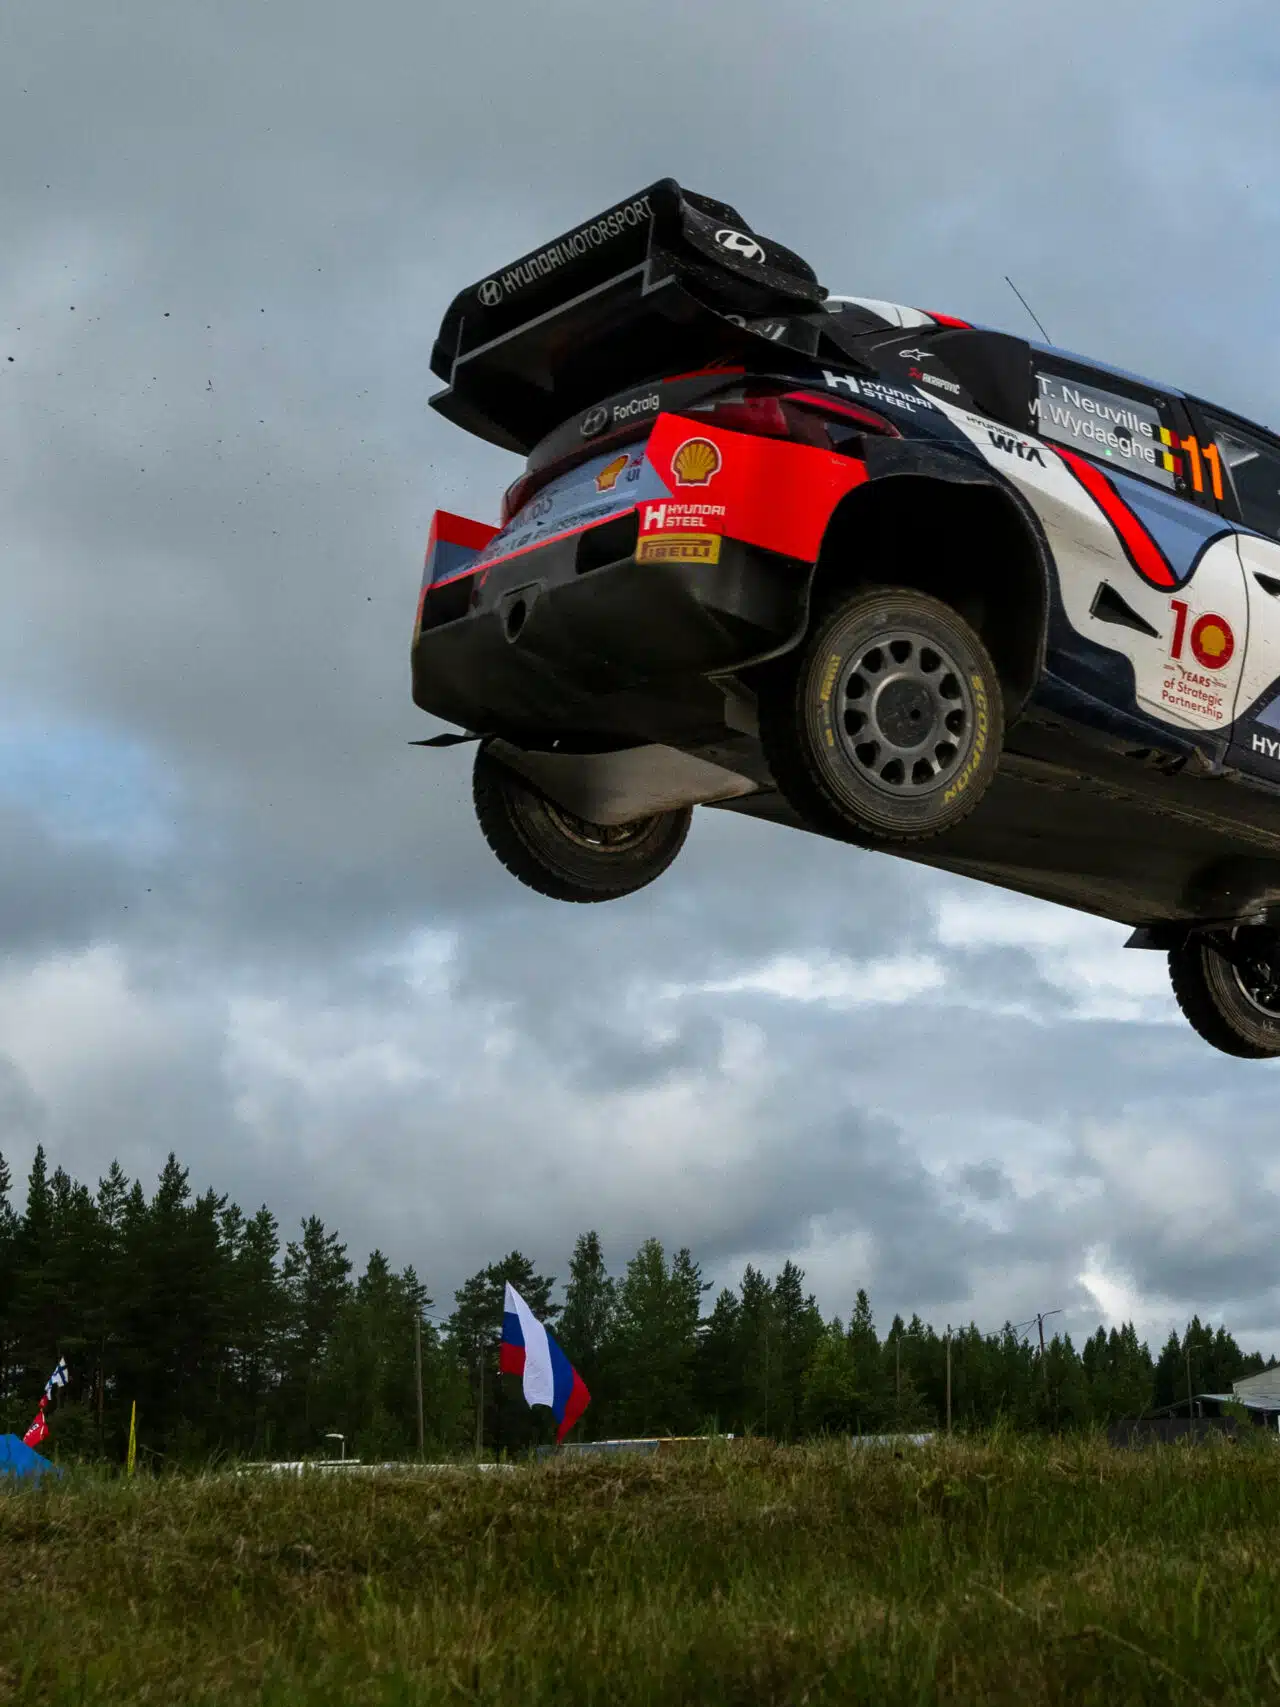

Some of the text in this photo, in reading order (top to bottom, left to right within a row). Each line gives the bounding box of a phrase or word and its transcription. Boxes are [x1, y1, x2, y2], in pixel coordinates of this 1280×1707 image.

[613, 393, 660, 422] ForCraig
[859, 378, 933, 410] HYUNDAI
[863, 386, 916, 414] STEEL
[1035, 374, 1154, 438] T. Neuville
[965, 415, 1020, 442] HYUNDAI
[1181, 435, 1224, 500] 11
[666, 516, 707, 528] STEEL
[667, 503, 726, 518] HYUNDAI
[640, 538, 712, 560] PIRELLI
[1178, 667, 1211, 688] YEARS
[1161, 689, 1224, 720] Partnership
[1163, 677, 1176, 689] of
[1177, 680, 1223, 707] Strategic
